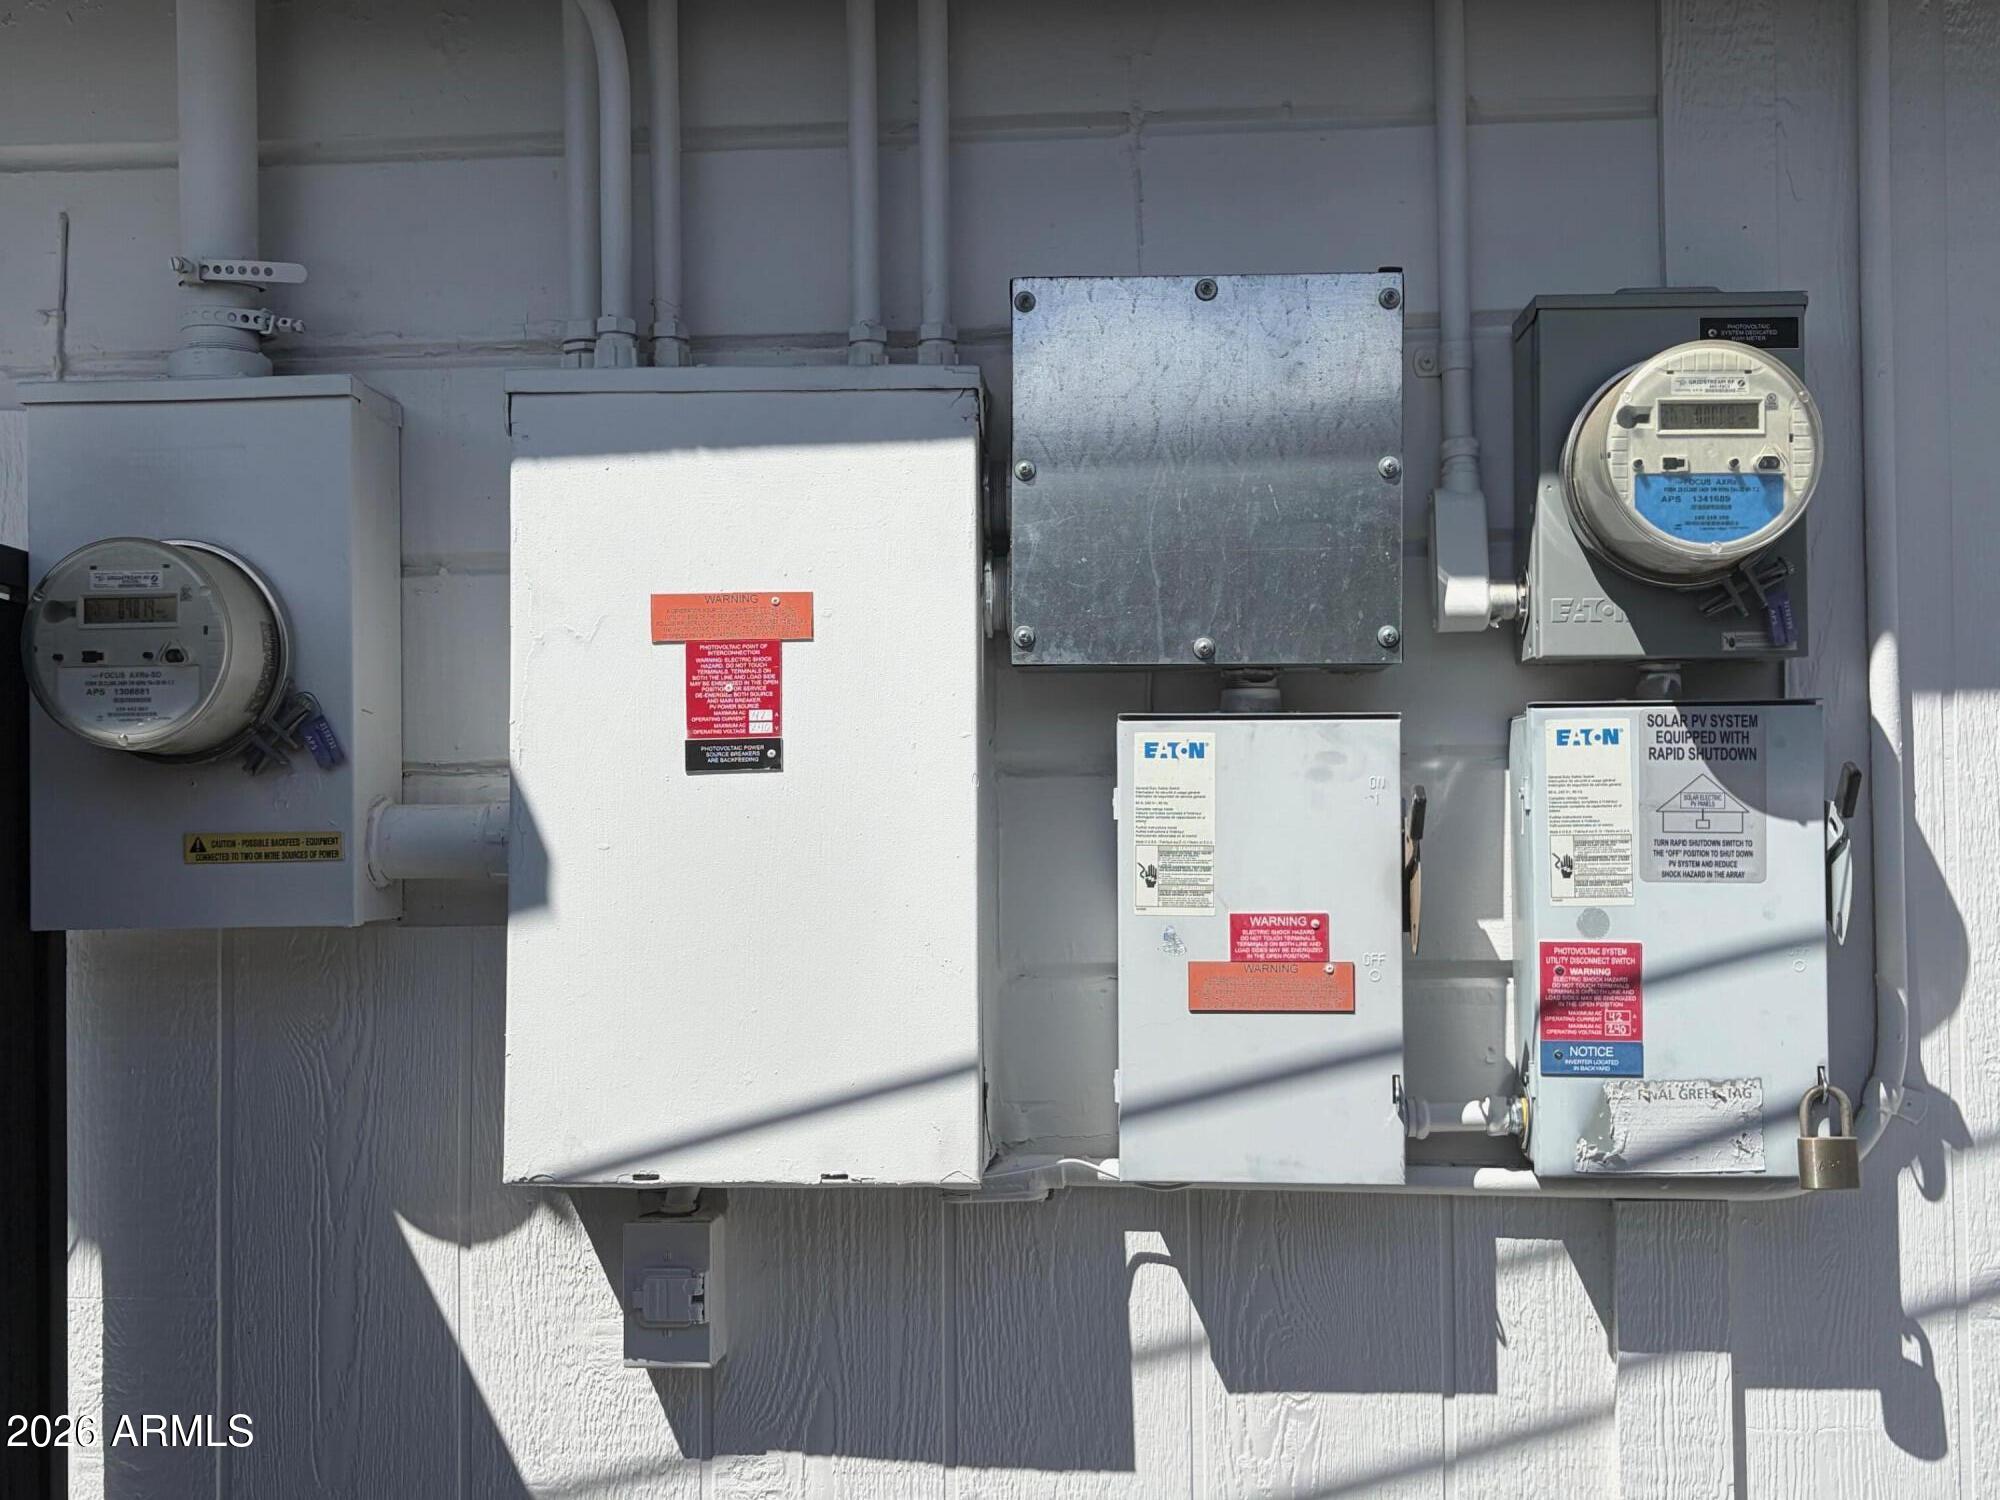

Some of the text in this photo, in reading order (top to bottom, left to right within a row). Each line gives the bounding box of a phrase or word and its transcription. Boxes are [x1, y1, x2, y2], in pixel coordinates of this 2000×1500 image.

[704, 594, 758, 604] WARNING
[1647, 714, 1758, 728] SOLAR PV SYSTEM
[1556, 729, 1620, 746] EATON
[1656, 730, 1749, 744] EQUIPPED WITH
[1144, 742, 1205, 759] EATON
[1649, 747, 1757, 760] RAPID SHUTDOWN
[211, 837, 338, 848] CAUTION POSSIBLE BACKFEED EQUIPMENT
[195, 850, 339, 861] CONNECTED TO TWO OR MORE SOURCES OF POWER
[1250, 916, 1306, 926] WARNING
[1243, 964, 1298, 973] WARNING
[1570, 1046, 1614, 1057] NOTICE
[1638, 1090, 1676, 1101] FNAL
